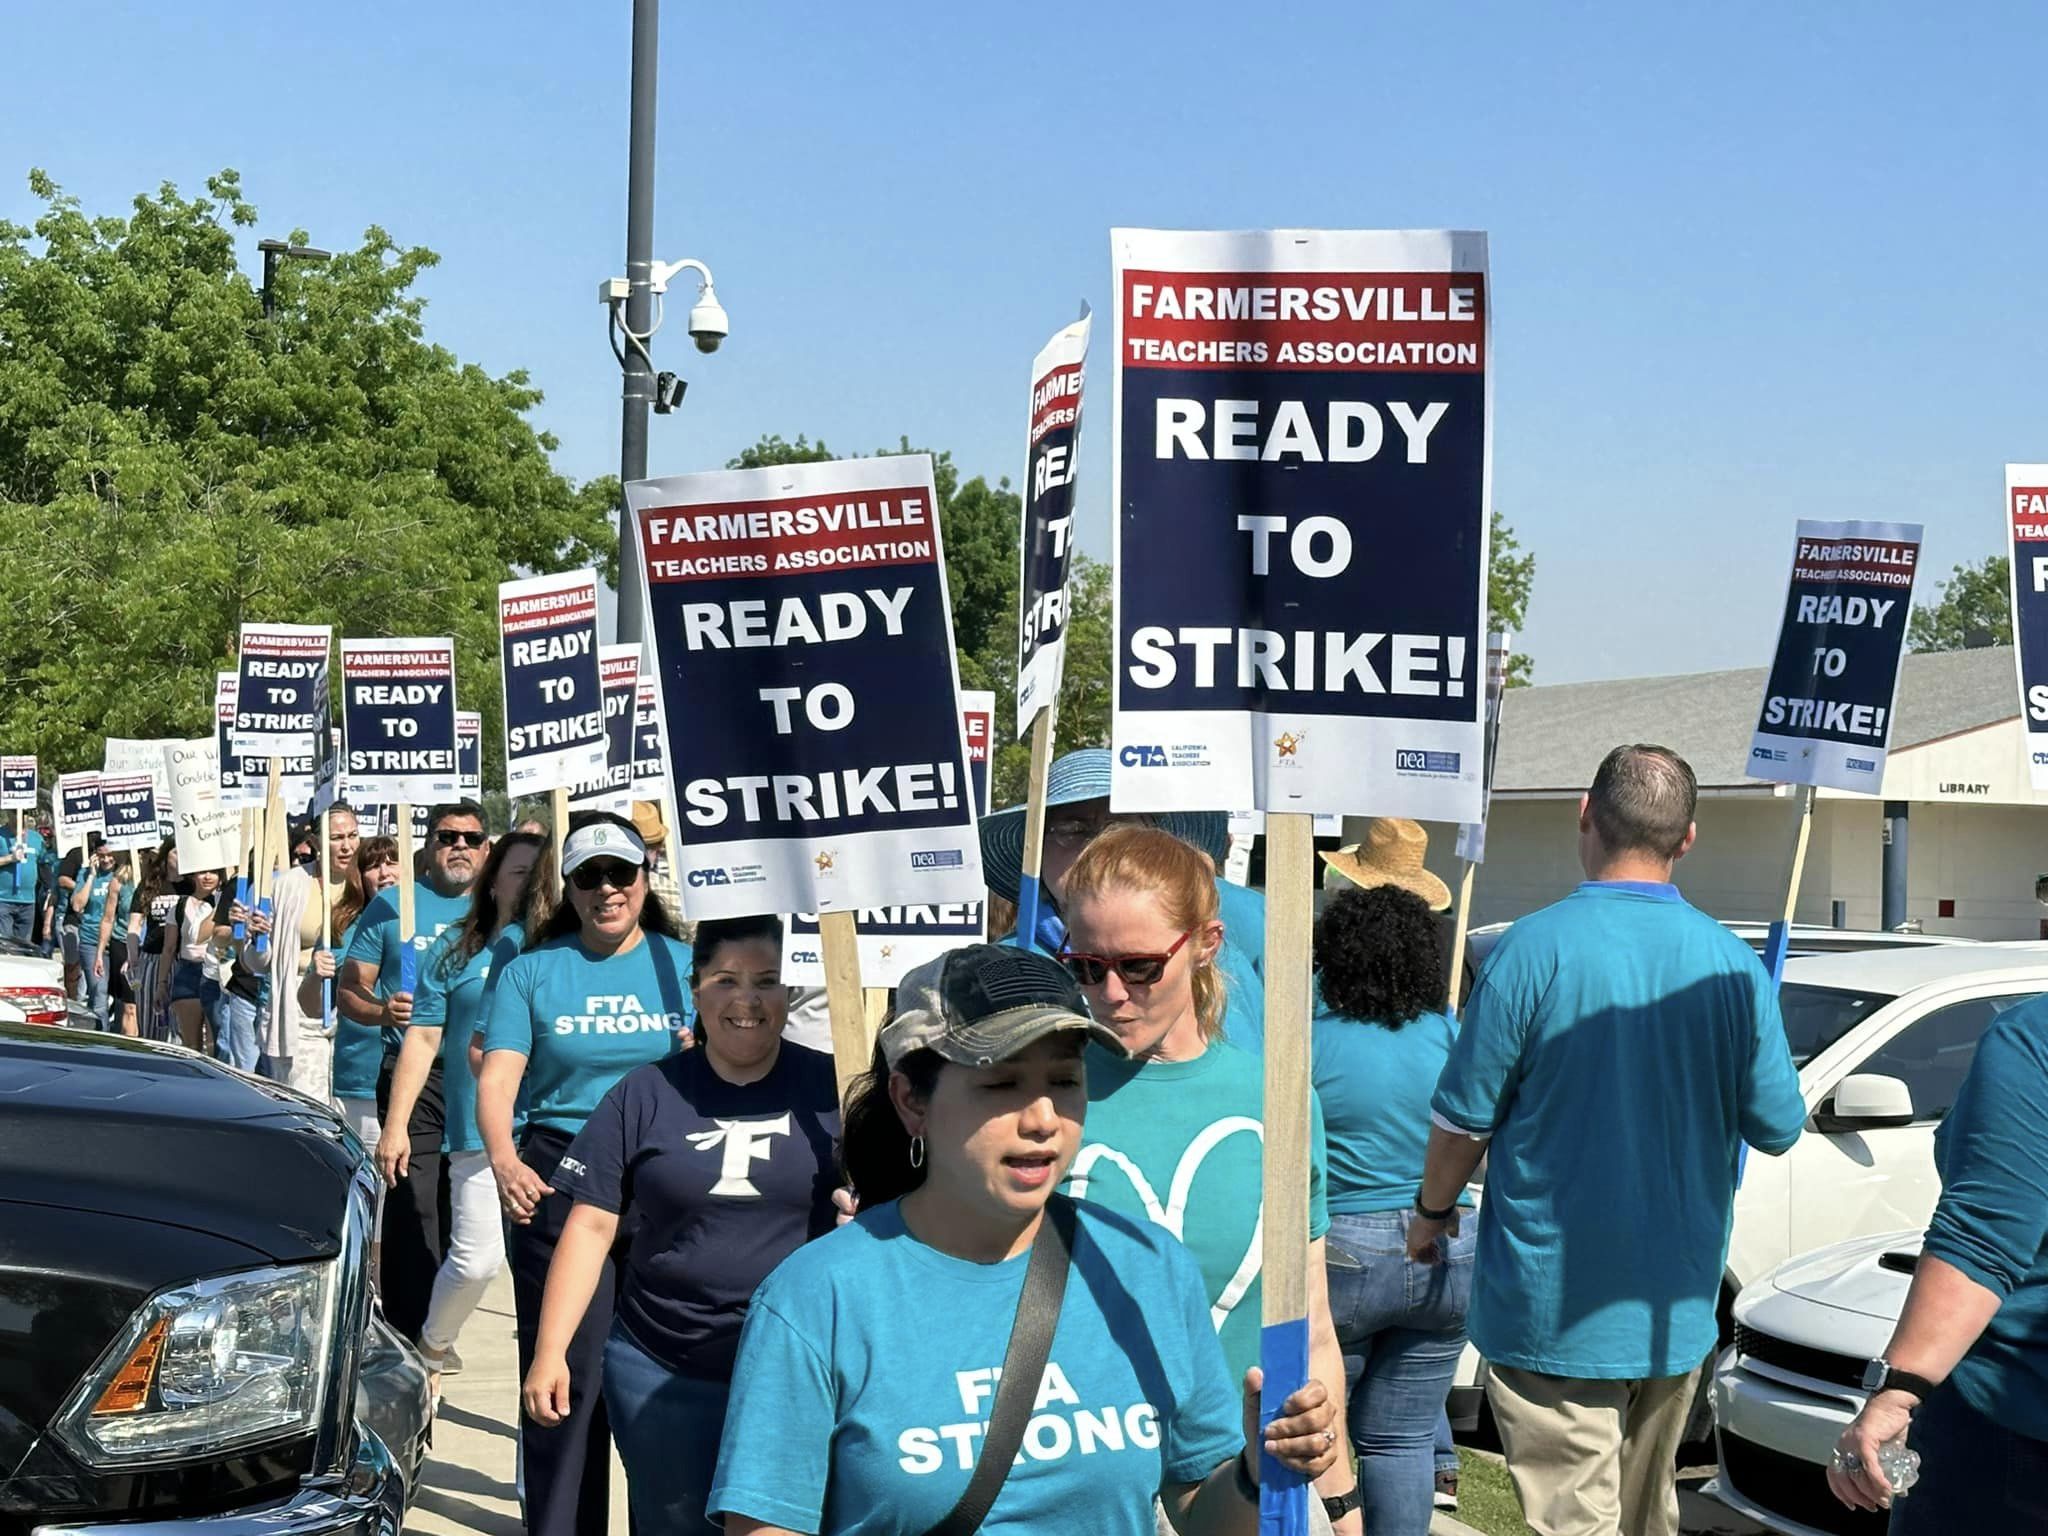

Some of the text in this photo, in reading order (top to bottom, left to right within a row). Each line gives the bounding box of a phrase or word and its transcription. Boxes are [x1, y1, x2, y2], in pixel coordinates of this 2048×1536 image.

[1131, 285, 1475, 322] FARMERSVILLE
[1129, 339, 1477, 364] TEACHERS ASSOCIATION
[1155, 398, 1450, 464] READY
[2016, 494, 2048, 514] FA
[650, 499, 925, 544] FARMERSVILLE
[1237, 514, 1353, 578] TO
[651, 541, 931, 578] TEACHERS ASSOCIATION
[1838, 569, 1911, 585] ASSOCIATION
[503, 589, 595, 617] FARMERSVILLE
[1797, 595, 1896, 628] READY
[682, 587, 914, 651] READY
[244, 635, 327, 647] FARMERSVILLE
[512, 630, 593, 667] READY
[248, 661, 320, 678] READY
[346, 653, 449, 665] FARMERSVILLE
[1129, 627, 1466, 698] STRIKE!
[1812, 647, 1847, 678] TO
[392, 669, 450, 677] ASSOCIATION
[267, 688, 297, 704] TO
[355, 685, 443, 704] READY
[539, 676, 575, 703] TO
[759, 682, 855, 735] TO
[1765, 696, 1886, 737] STRIKE!
[381, 718, 418, 737] TO
[510, 711, 604, 752] STRIKE!
[350, 750, 453, 770] STRIKE!
[1120, 745, 1169, 767] CTA
[1398, 752, 1426, 769] nea
[65, 788, 98, 799] READY
[106, 791, 149, 805] READY
[685, 763, 958, 828] STRIKE!
[1940, 783, 1991, 794] LIBRARY
[75, 801, 90, 810] TO
[120, 808, 139, 819] TO
[107, 821, 156, 836] STRIKE!
[912, 852, 935, 867] nea
[688, 868, 731, 887] CTA
[791, 951, 819, 964] CTA
[586, 994, 644, 1014] FTA
[555, 1012, 681, 1035] STRONG
[955, 1362, 1080, 1415] FA
[897, 1402, 1161, 1475] STONG
